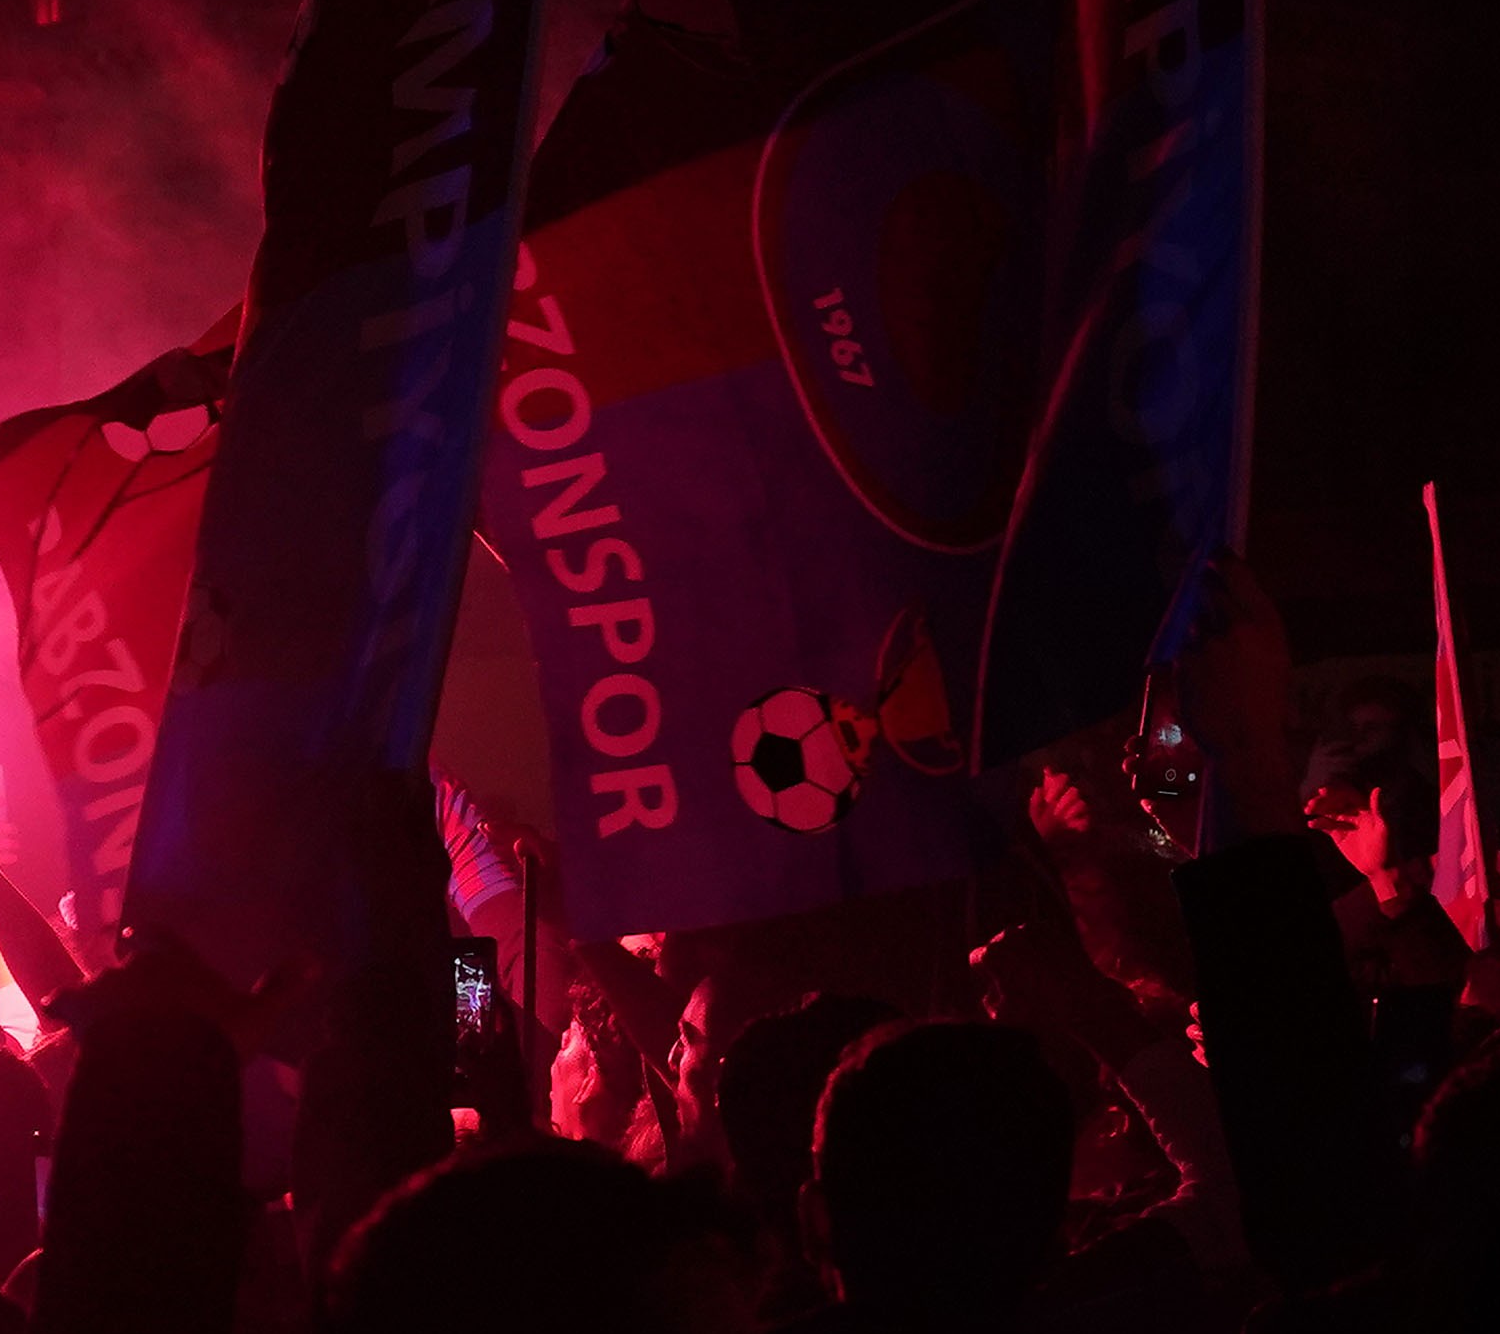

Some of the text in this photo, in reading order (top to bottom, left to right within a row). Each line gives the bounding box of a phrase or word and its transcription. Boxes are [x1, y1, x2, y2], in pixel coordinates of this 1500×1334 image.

[500, 242, 681, 839] ZONSPOR
[813, 287, 875, 387] 1967
[27, 505, 157, 925] ABZON
